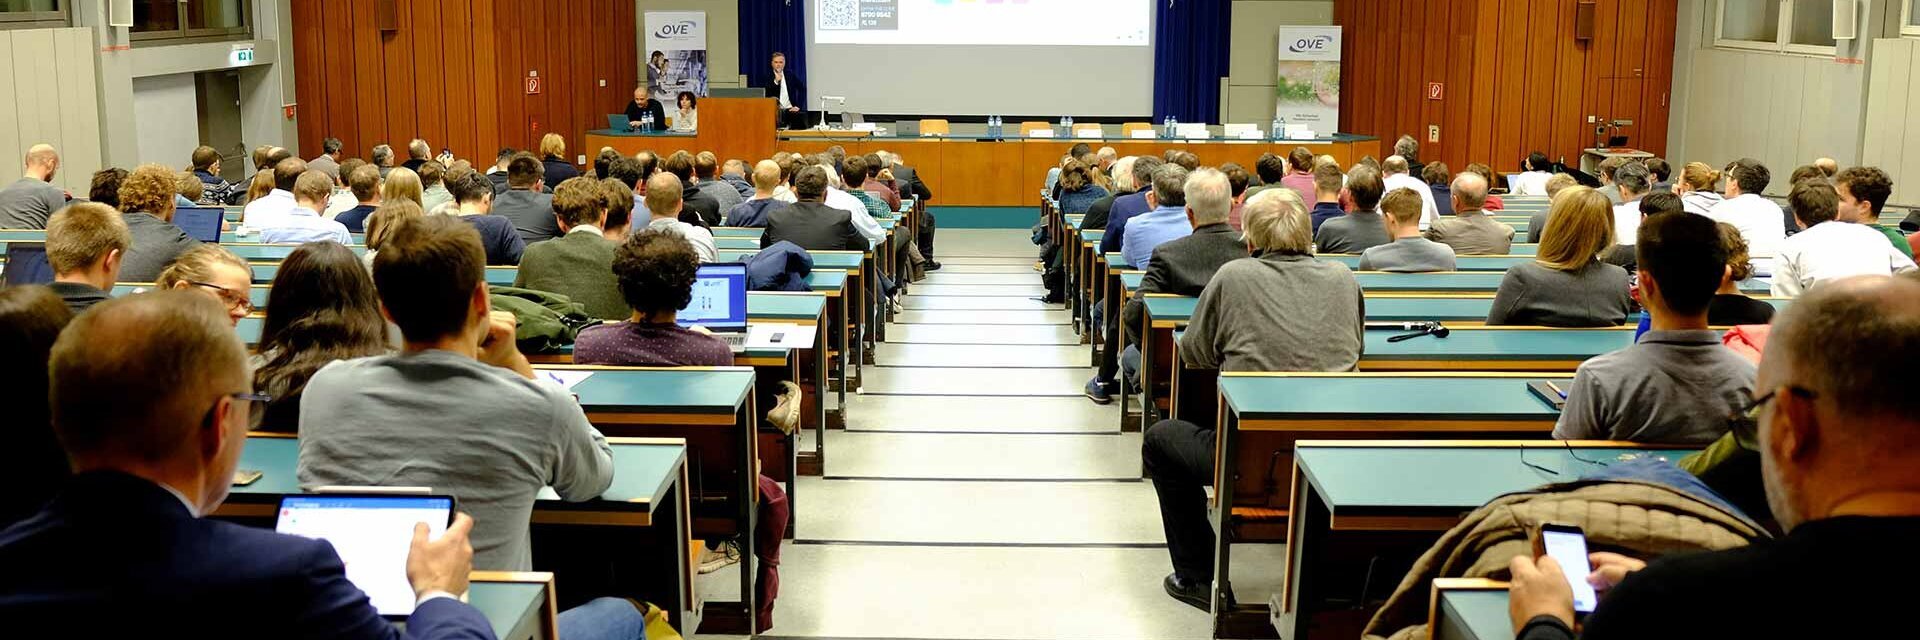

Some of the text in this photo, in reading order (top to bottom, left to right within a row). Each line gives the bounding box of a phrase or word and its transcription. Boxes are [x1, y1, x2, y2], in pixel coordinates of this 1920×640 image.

[662, 24, 689, 35] OVE
[1296, 38, 1324, 49] OVE
[1431, 129, 1437, 140] F
